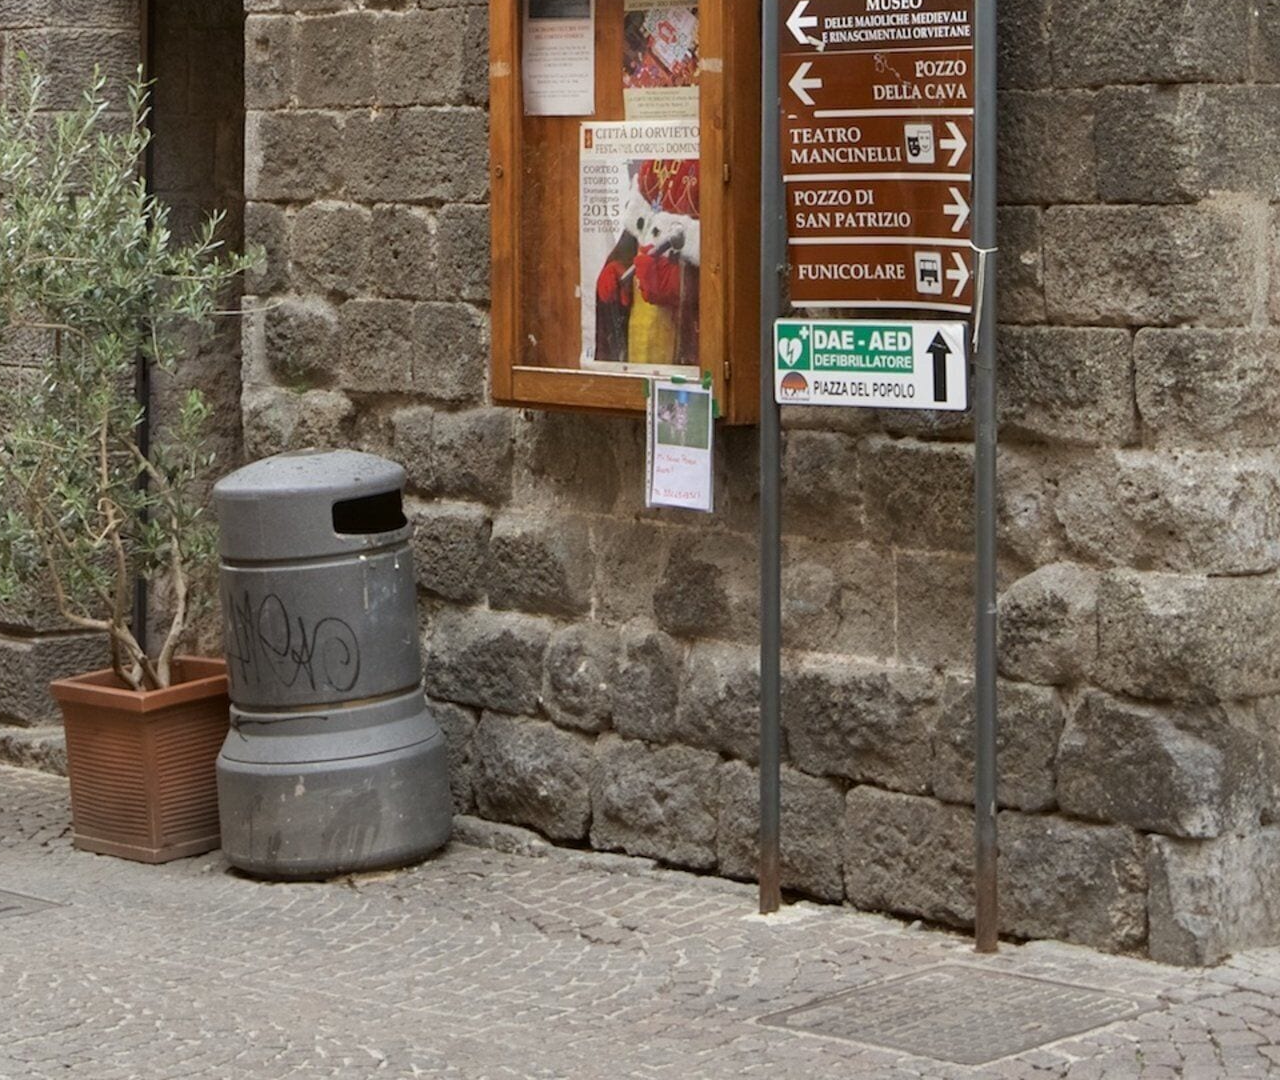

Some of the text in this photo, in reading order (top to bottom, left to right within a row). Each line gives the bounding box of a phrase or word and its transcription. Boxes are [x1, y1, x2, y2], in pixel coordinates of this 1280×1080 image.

[824, 11, 968, 29] DELLE MAIOLICHE MEDIEVALI
[829, 29, 911, 43] RINASCIMENTALI
[912, 25, 971, 39] ORVIETANE
[915, 60, 967, 78] POZZO
[873, 83, 967, 100] DELLA CAVA
[595, 125, 700, 139] CITTÀ DI ORVIETO
[789, 127, 861, 145] TEATRO
[790, 146, 901, 164] MANCINELLI
[583, 165, 619, 174] CORTEO
[583, 177, 619, 185] STORICO
[794, 190, 874, 206] POZZO DI
[583, 204, 620, 217] 2015
[583, 218, 620, 226] Duomo
[795, 212, 911, 229] SAN PATRIZIO
[798, 264, 906, 280] FUNICOLARE
[814, 330, 854, 350] DAE
[869, 331, 913, 351] AED
[814, 354, 913, 369] DEFIBRILLATORE
[813, 380, 915, 399] PIAZZA DEL POPOLO
